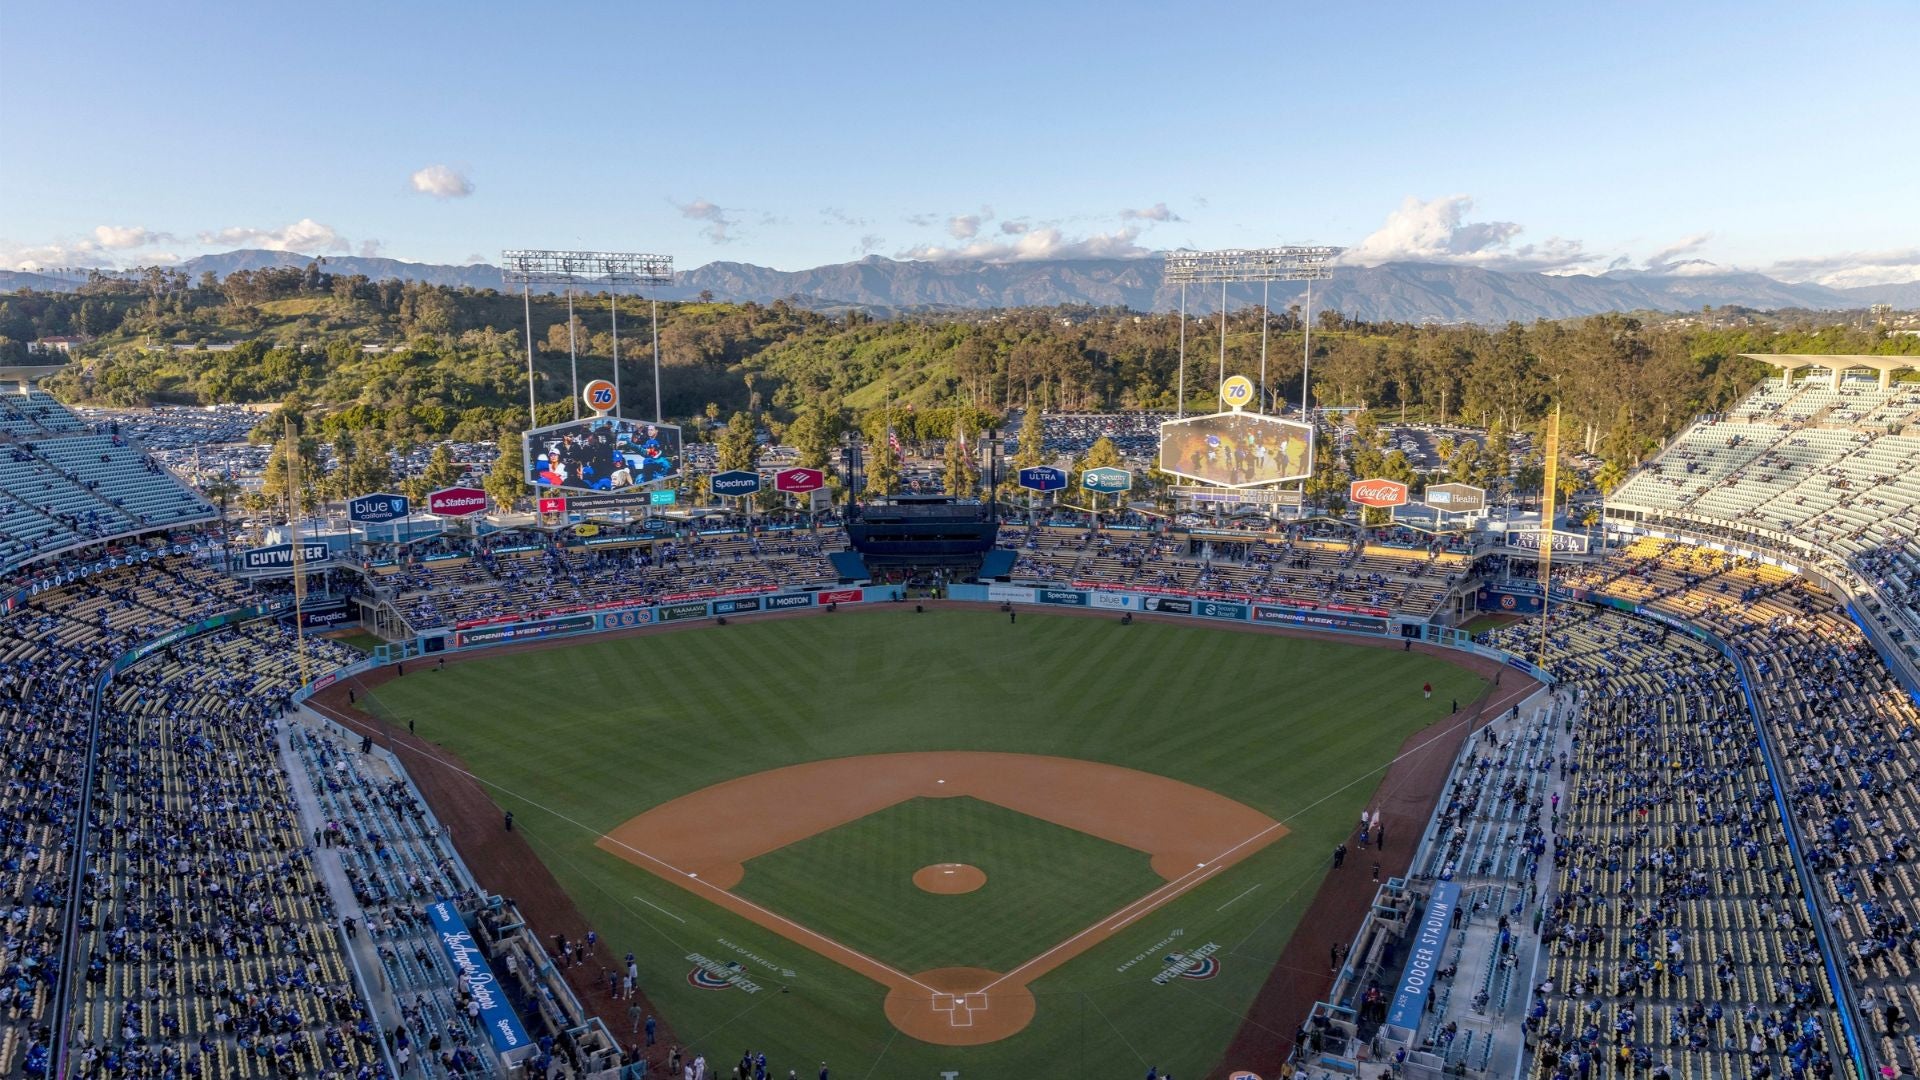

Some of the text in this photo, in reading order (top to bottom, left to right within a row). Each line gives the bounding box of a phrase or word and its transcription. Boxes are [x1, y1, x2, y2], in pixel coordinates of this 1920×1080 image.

[594, 389, 612, 402] 76
[1228, 384, 1246, 398] 76
[715, 479, 754, 489] Spectrum
[1452, 494, 1479, 503] Health
[355, 501, 388, 514] blue
[776, 596, 808, 606] MORTON
[1100, 596, 1119, 604] blue
[1217, 604, 1238, 613] Security
[310, 612, 347, 623] Fanatics
[1266, 612, 1305, 621] OPENING
[1307, 616, 1333, 624] WEEK
[472, 630, 514, 641] OPENING
[516, 627, 542, 636] WEEK
[435, 902, 449, 921] Spectrum
[1405, 903, 1449, 994] DODGER STADIUM
[1152, 941, 1221, 985] OPENING WEEK
[685, 953, 764, 994] OPENING WEEK
[469, 973, 498, 1010] Dodgers
[498, 1018, 517, 1045] Spectrum
